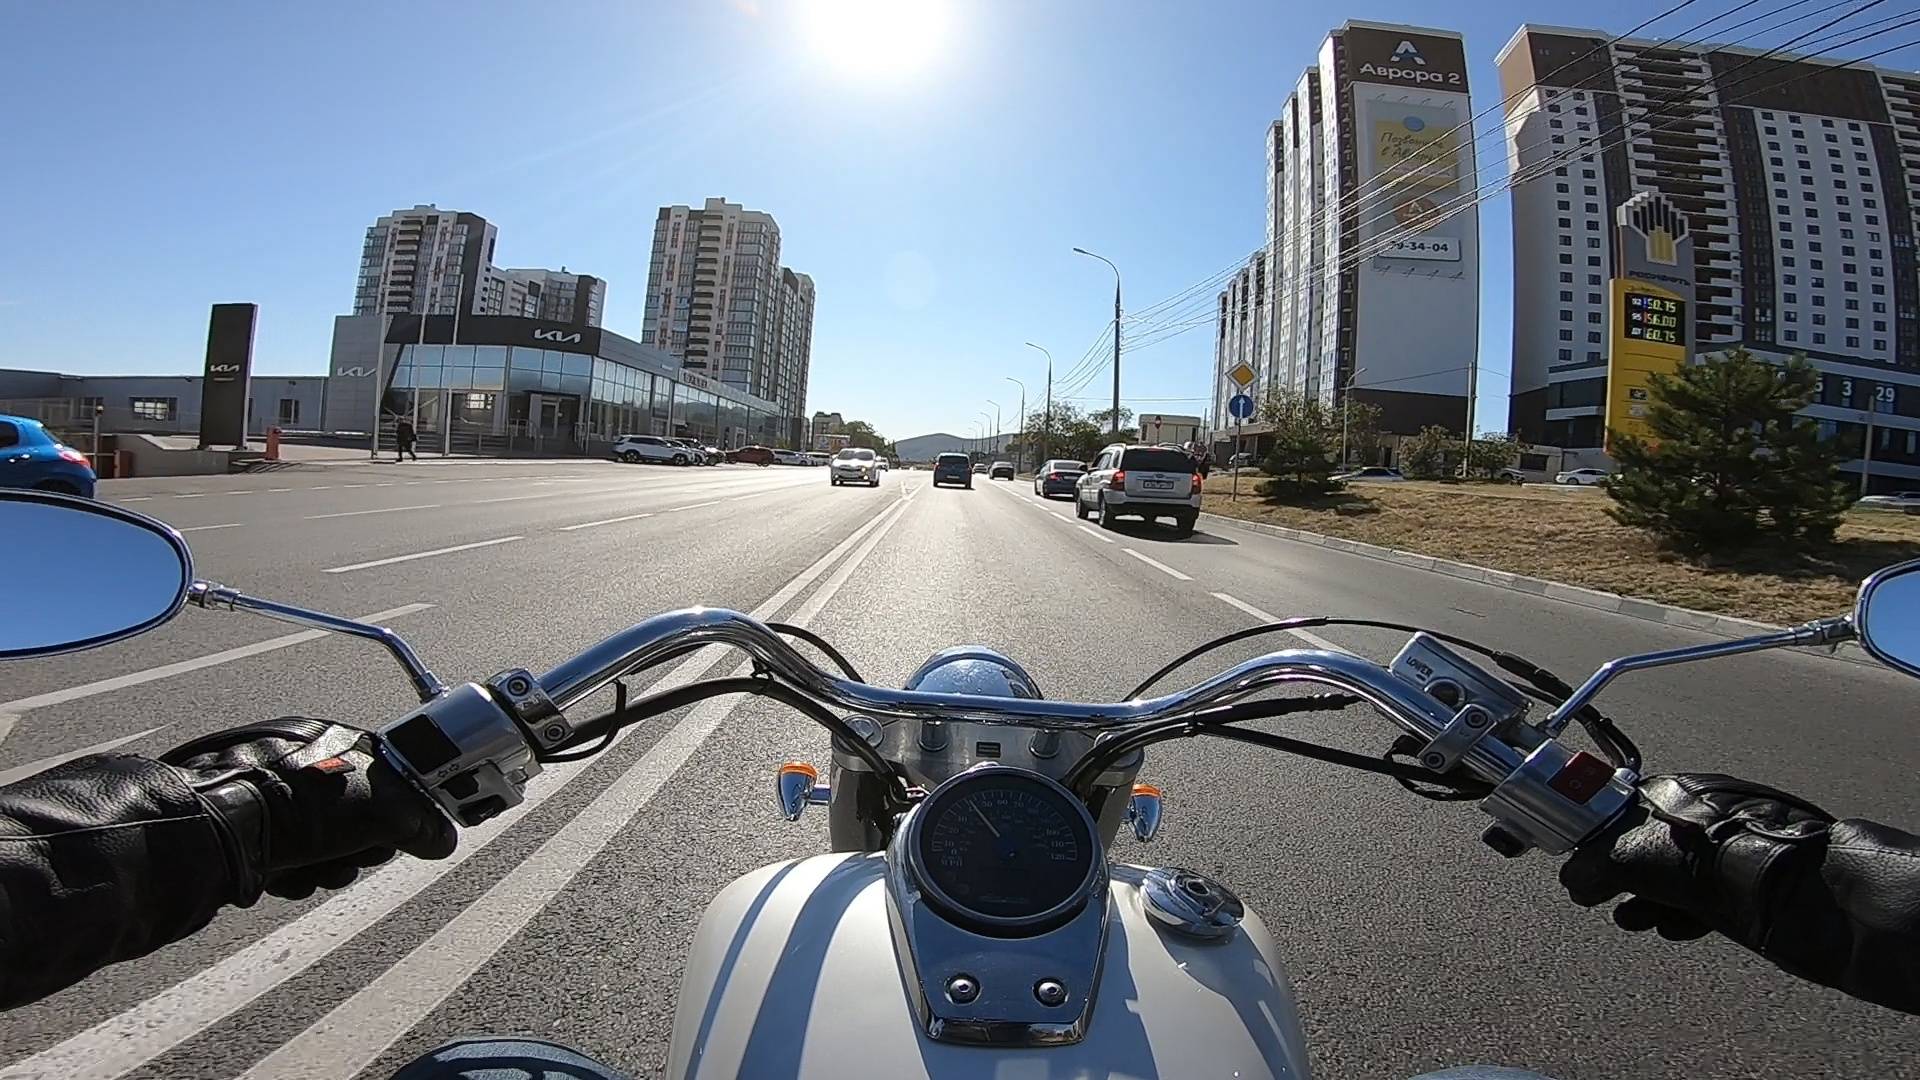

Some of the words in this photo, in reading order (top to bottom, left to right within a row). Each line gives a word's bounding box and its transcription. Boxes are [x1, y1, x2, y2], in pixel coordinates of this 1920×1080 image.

[1360, 63, 1444, 84] Аврора
[1448, 72, 1461, 85] 2
[1841, 381, 1852, 397] 3
[1875, 386, 1896, 402] 29
